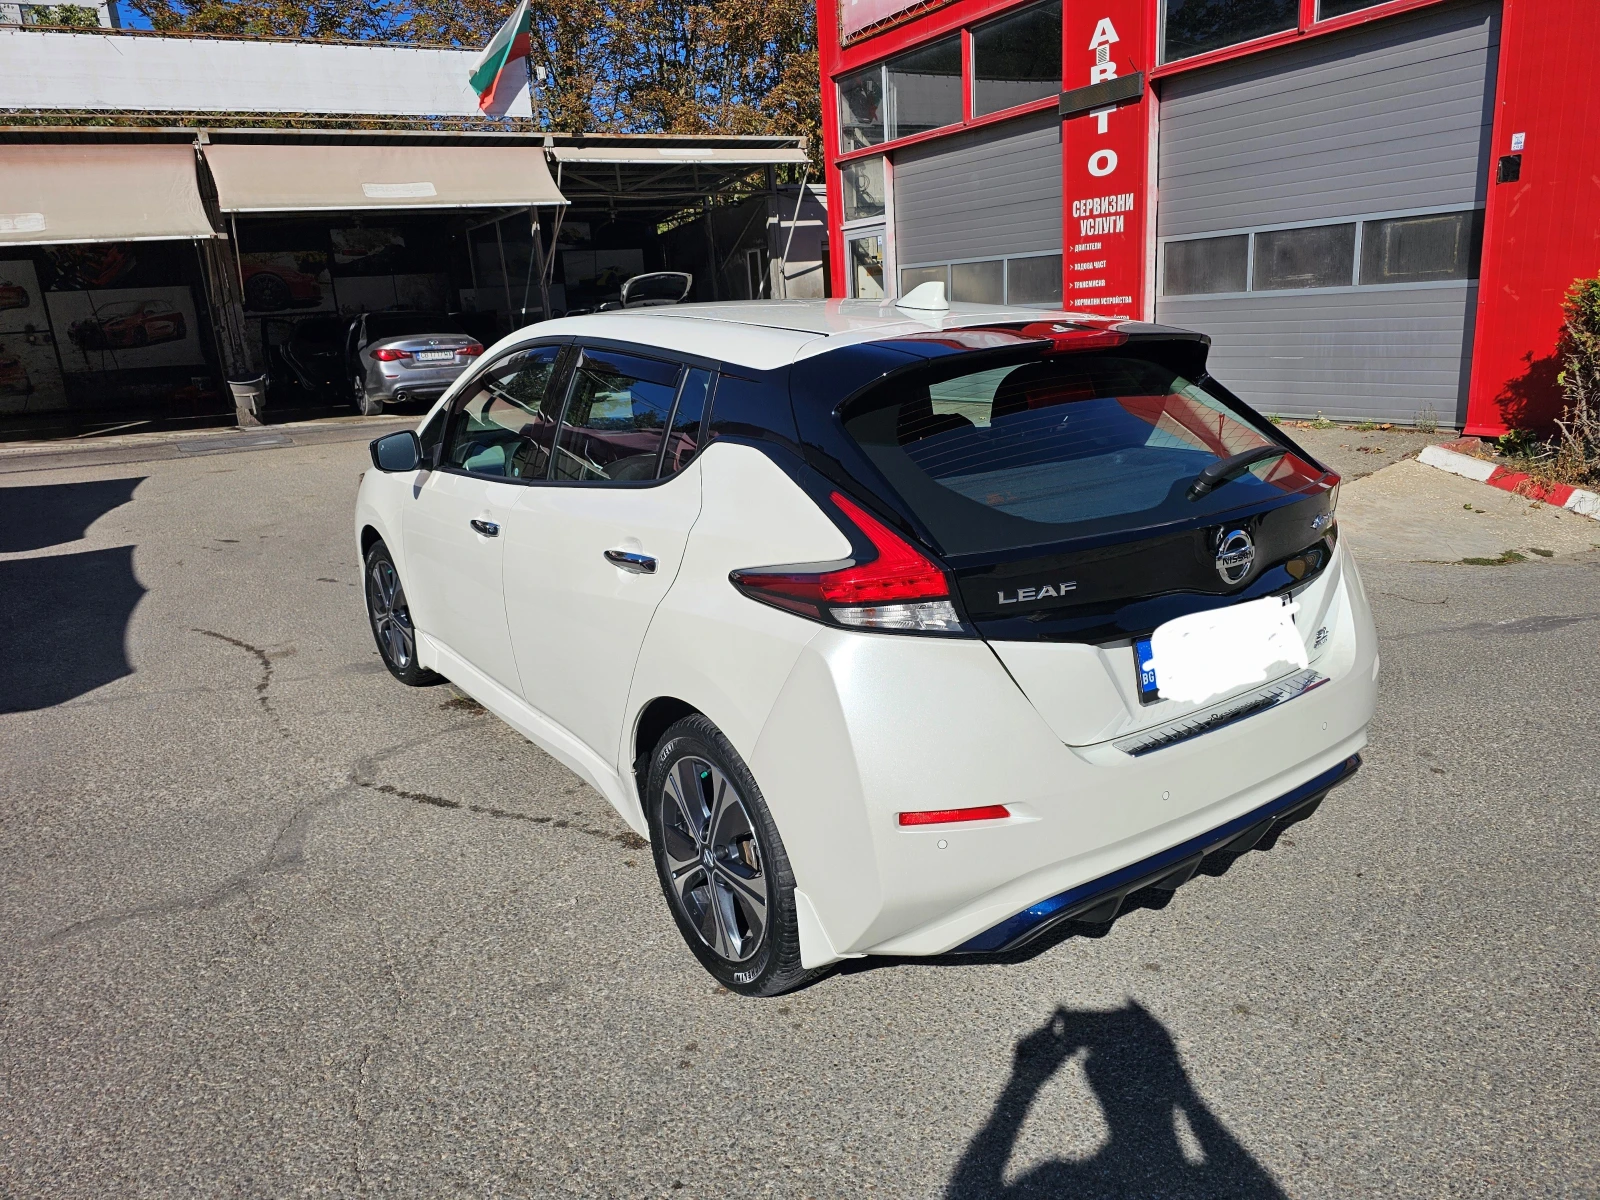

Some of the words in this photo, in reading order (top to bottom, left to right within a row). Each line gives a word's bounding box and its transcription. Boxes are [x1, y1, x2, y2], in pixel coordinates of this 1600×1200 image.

[1072, 193, 1134, 218] СЕРВИЗНИ
[1080, 215, 1124, 237] УСЛУГИ
[1101, 295, 1132, 305] УСТРОЙСТВА
[1222, 549, 1254, 566] NISSAN
[997, 581, 1077, 605] LEAF
[1142, 671, 1155, 686] BG
